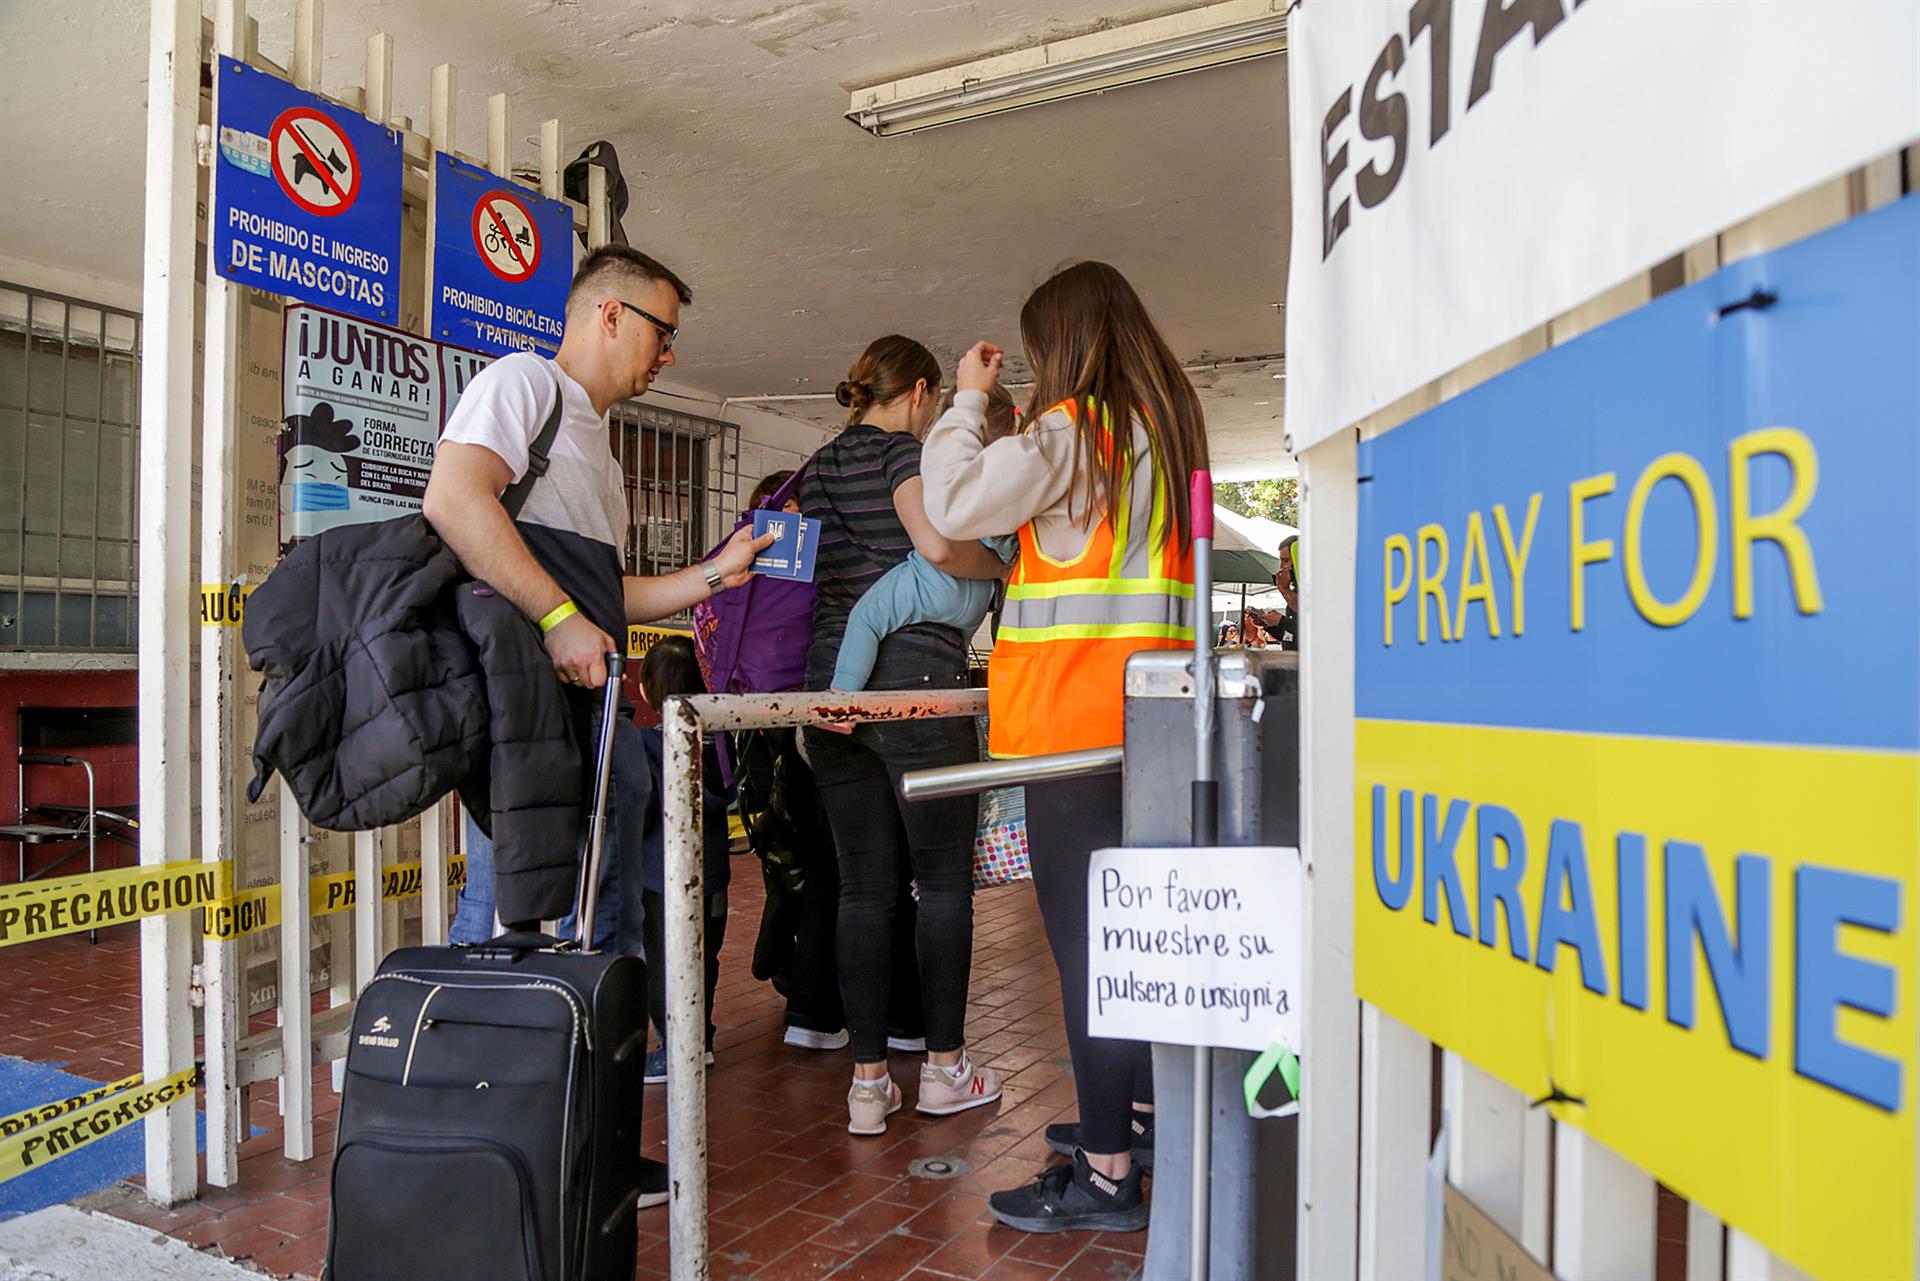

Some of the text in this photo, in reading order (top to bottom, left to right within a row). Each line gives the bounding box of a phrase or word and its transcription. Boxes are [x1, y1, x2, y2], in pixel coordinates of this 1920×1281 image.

[1321, 0, 1588, 262] ESTA
[229, 207, 389, 275] PROHIBIDO EL INGRESO
[231, 240, 262, 272] DE
[269, 250, 384, 307] MASCOTAS
[443, 286, 563, 337] PROHIBIDO BICICLETAS
[299, 313, 429, 383] ¡JUNTOS
[475, 321, 536, 352] Y PATINES
[299, 360, 311, 379] A
[332, 366, 430, 405] GANAR!
[363, 430, 434, 458] CORRECTA
[364, 417, 397, 433] FORMA
[361, 462, 389, 473] CUBRIRSE
[398, 468, 412, 476] BOCA
[417, 471, 431, 479] NARI
[362, 447, 371, 455] DE
[372, 449, 411, 462] ESTORNUDAR
[412, 455, 416, 463] O
[360, 479, 371, 487] DEL
[361, 471, 373, 479] CON
[404, 478, 426, 487] INTERNO
[383, 498, 394, 506] CON
[395, 500, 407, 508] LAS
[1384, 427, 1824, 646] PRAY FOR
[0, 871, 216, 940] PRECAUCION
[1101, 868, 1241, 913] Por favor,
[1102, 923, 1274, 959] muestre su
[1372, 783, 1904, 1116] UKRAINE
[1097, 970, 1290, 1022] pulsera o insignia
[20, 1074, 198, 1167] PRECAUCIO
[1089, 1171, 1119, 1197] PUMA
